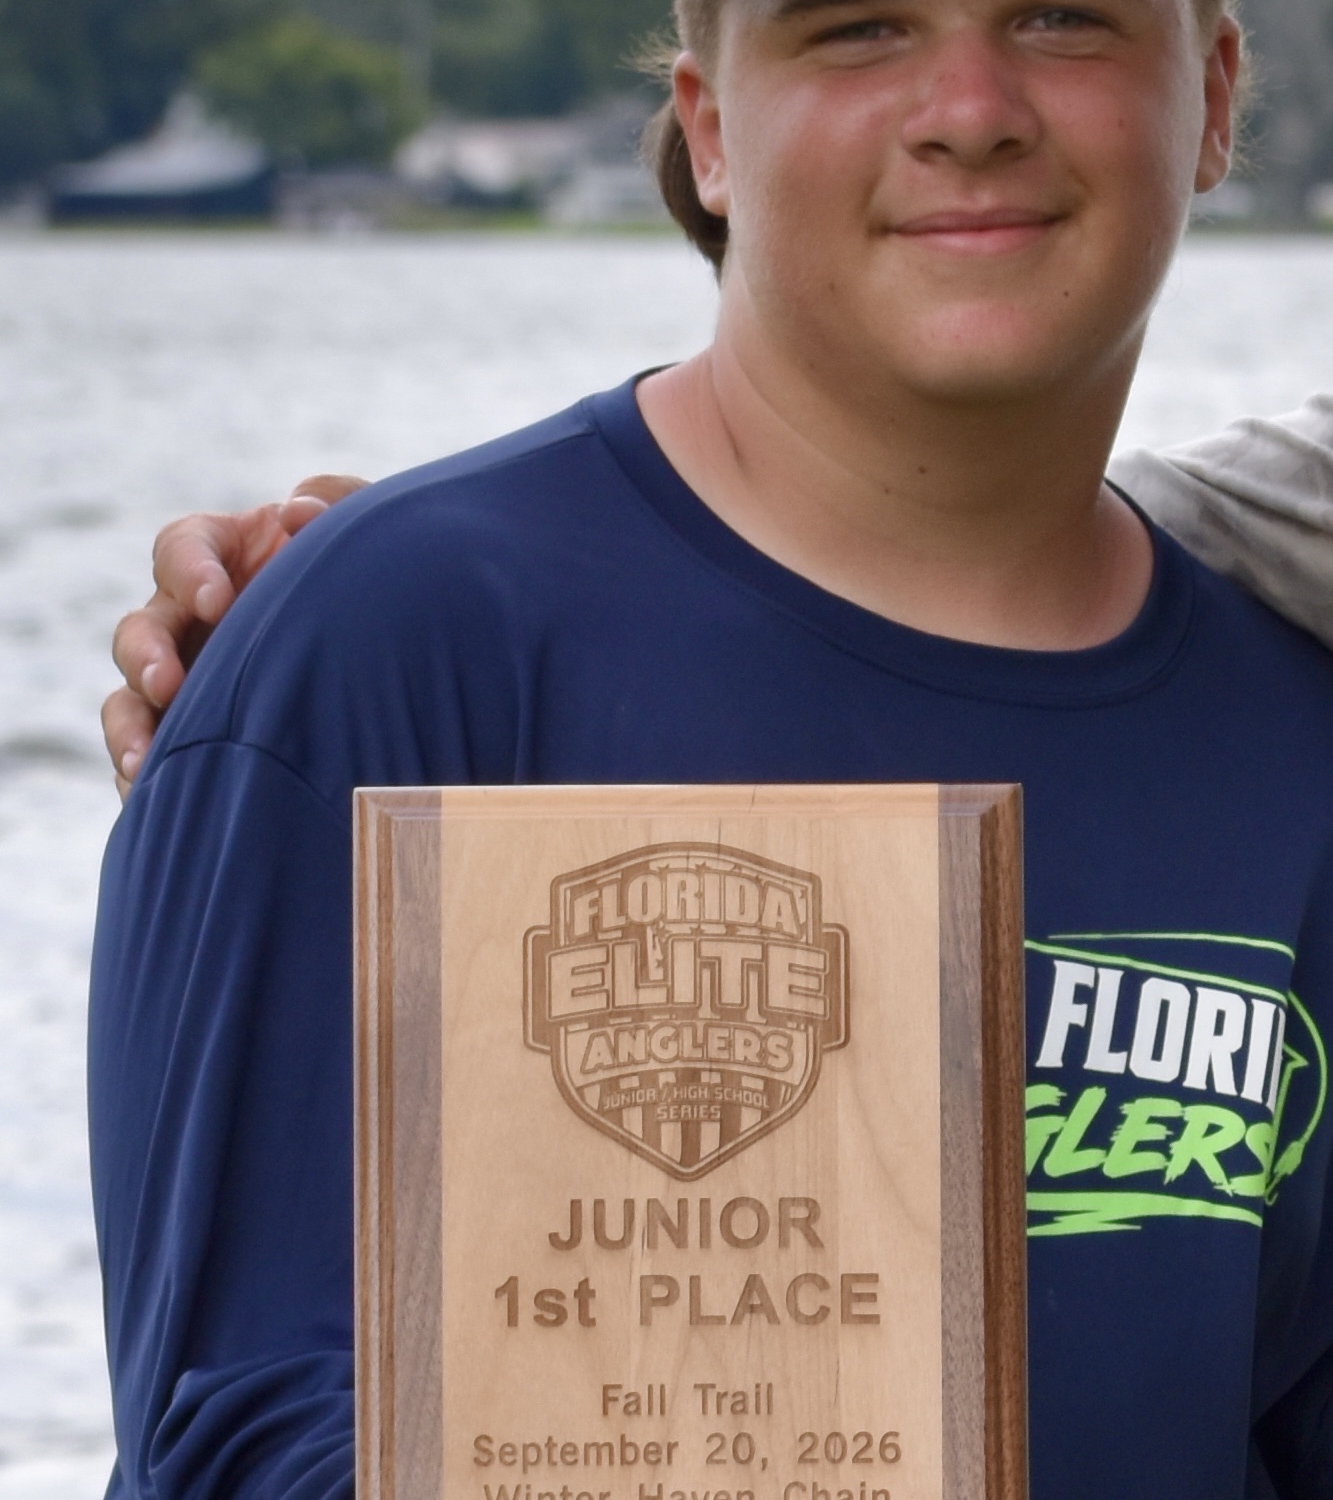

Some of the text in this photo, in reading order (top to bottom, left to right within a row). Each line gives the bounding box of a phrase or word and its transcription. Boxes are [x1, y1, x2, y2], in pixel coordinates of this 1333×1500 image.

[571, 870, 801, 938] FLORIDA
[549, 937, 827, 1018] ELITE
[582, 1023, 793, 1073] ANGLERS
[1035, 960, 1286, 1112] FLORI
[603, 1087, 657, 1110] JUNIOR
[673, 1086, 708, 1100] HIGH
[715, 1086, 770, 1109] SCHOOL
[657, 1105, 721, 1120] SERIES
[548, 1196, 825, 1251] JUNIOR
[495, 1273, 881, 1328] 1st PLACE
[602, 1382, 774, 1416] Fall Trail
[472, 1430, 903, 1474] September 20, 2026
